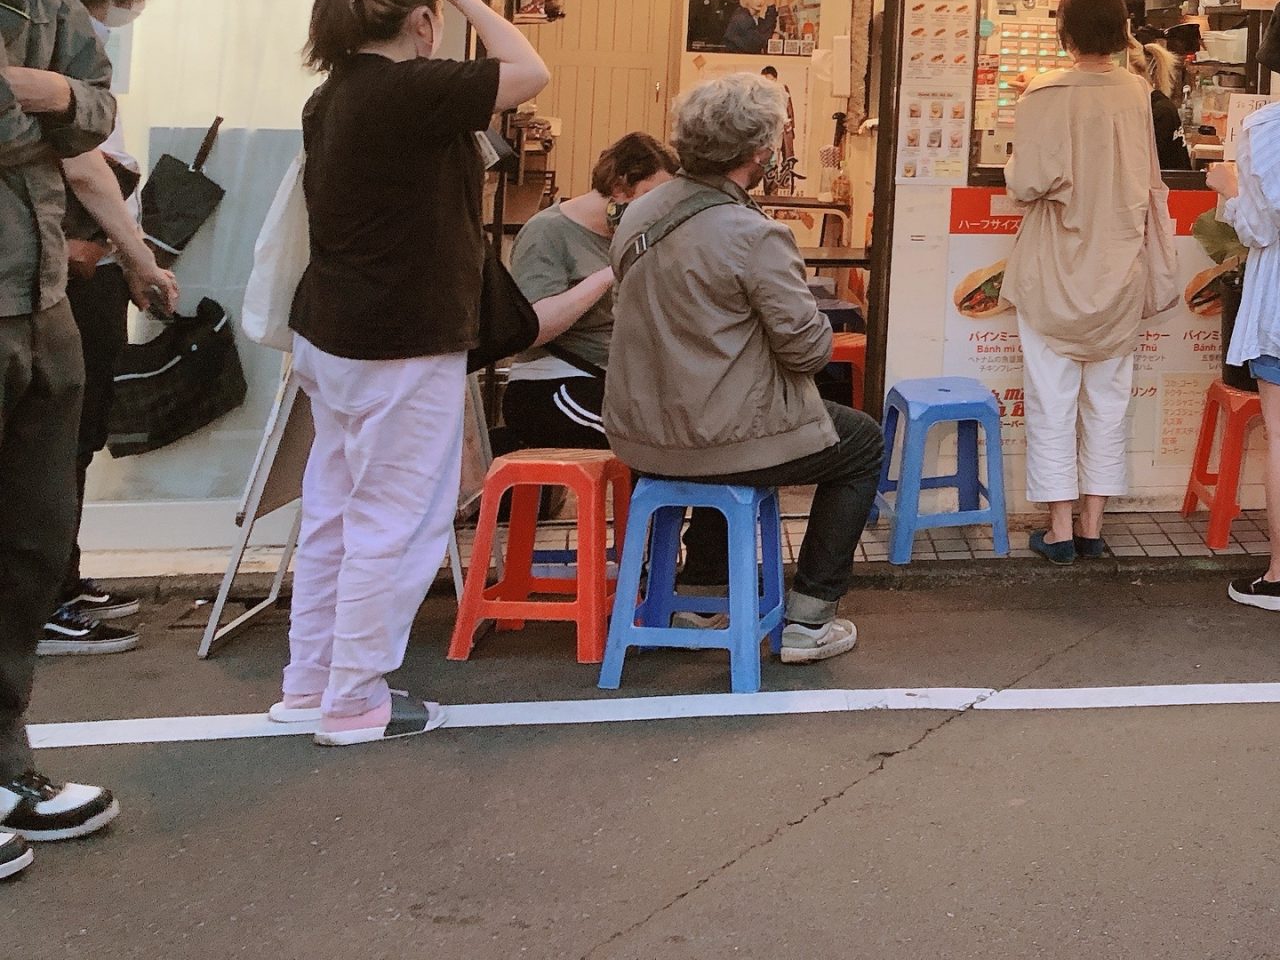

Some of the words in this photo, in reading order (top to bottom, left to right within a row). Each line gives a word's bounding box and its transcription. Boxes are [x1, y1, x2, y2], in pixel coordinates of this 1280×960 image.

[969, 331, 1019, 342] バインミー
[1183, 329, 1222, 341] バインミ
[1130, 386, 1158, 397] リンク
